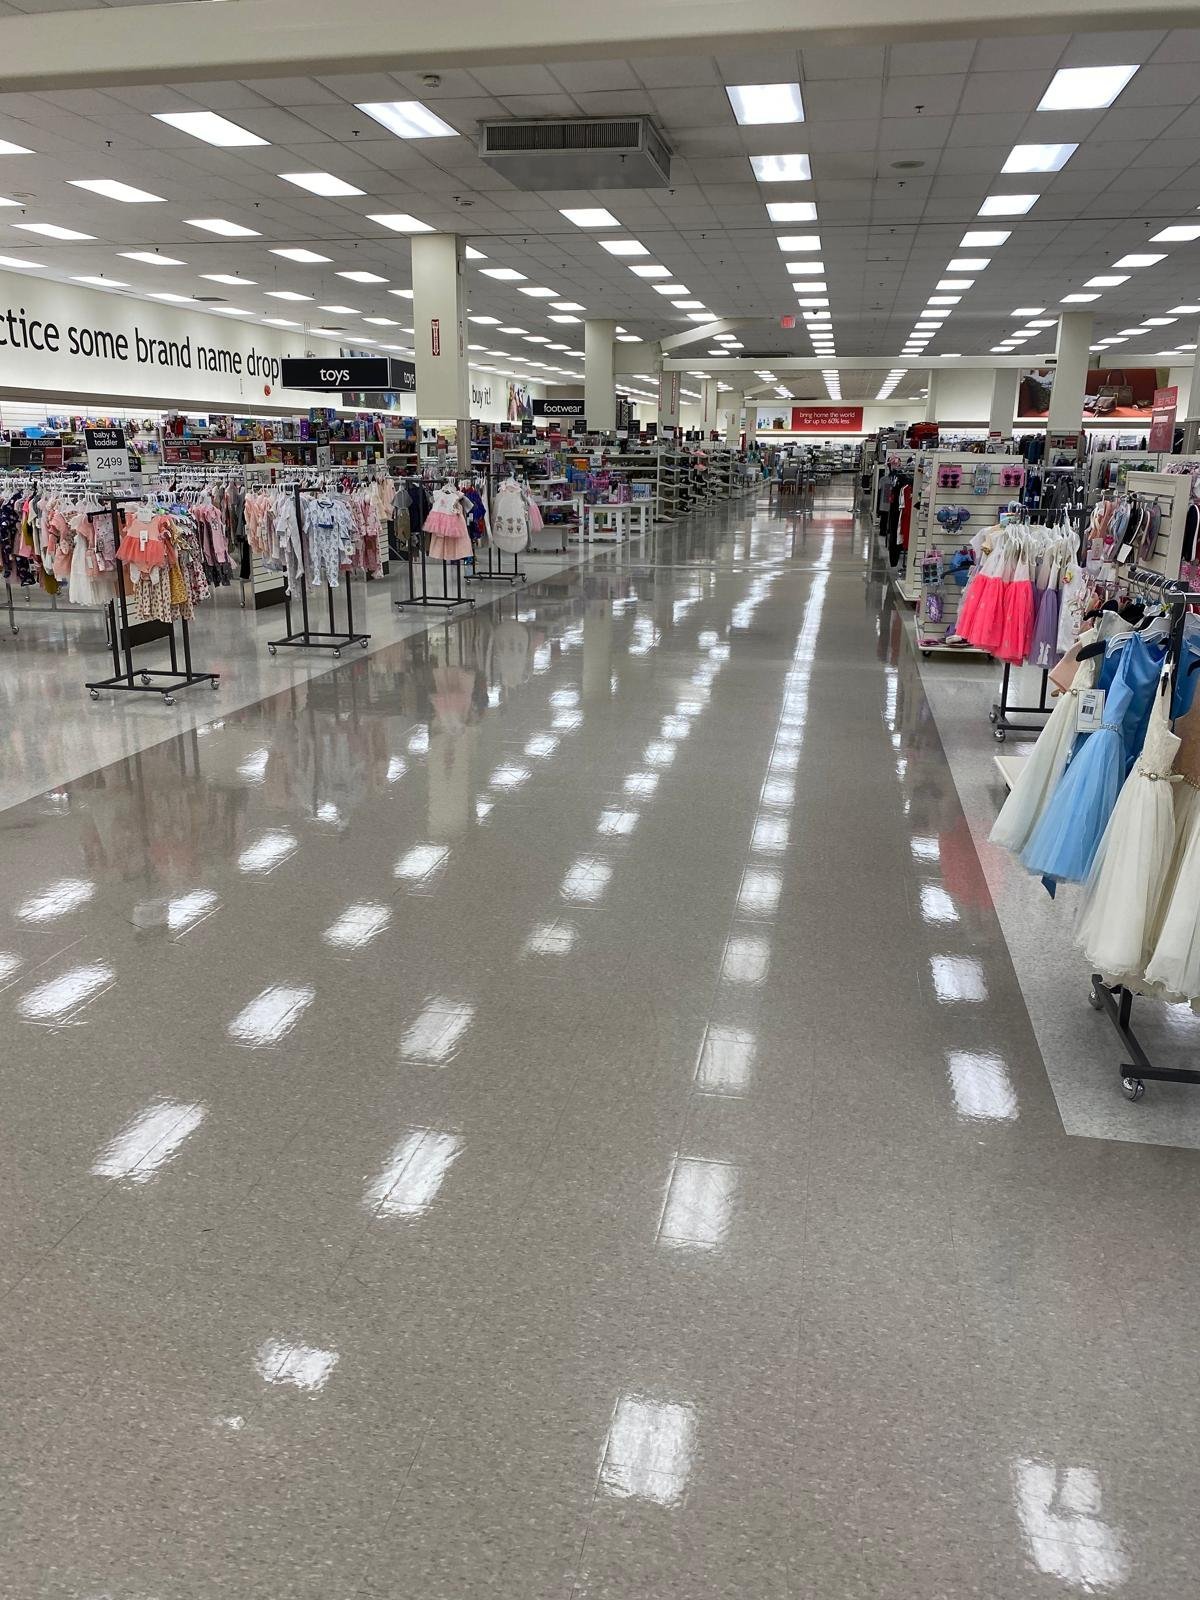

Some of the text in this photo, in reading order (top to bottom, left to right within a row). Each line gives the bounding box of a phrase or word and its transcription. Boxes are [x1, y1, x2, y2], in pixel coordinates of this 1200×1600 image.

[68, 326, 128, 361] some
[135, 327, 191, 369] brand
[198, 346, 242, 374] name
[246, 347, 280, 386] drop
[319, 366, 350, 386] toys
[403, 371, 415, 389] toys
[471, 384, 483, 408] buy
[543, 402, 582, 414] footwear
[93, 431, 110, 439] baby
